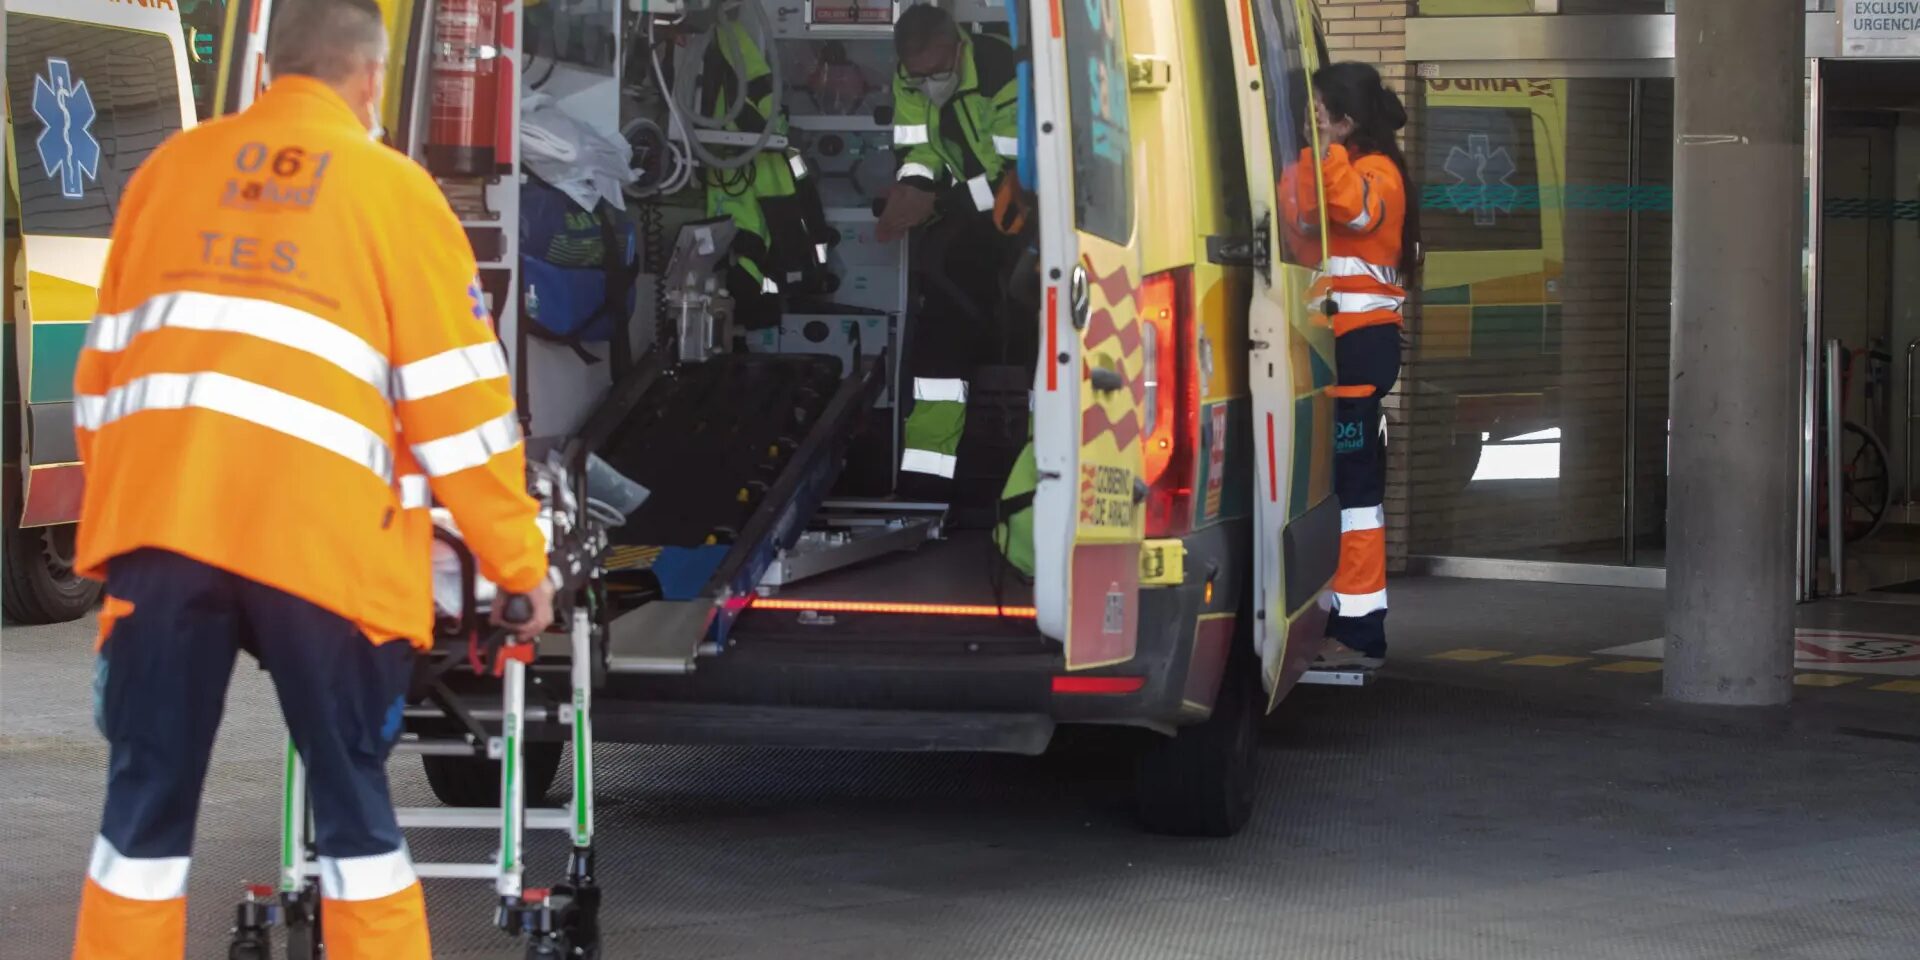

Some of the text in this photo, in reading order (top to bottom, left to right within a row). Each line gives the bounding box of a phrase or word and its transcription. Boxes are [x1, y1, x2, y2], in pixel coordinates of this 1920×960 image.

[1855, 2, 1920, 14] EXCLUSIV
[234, 141, 332, 182] 061
[199, 229, 308, 280] T.E.S.
